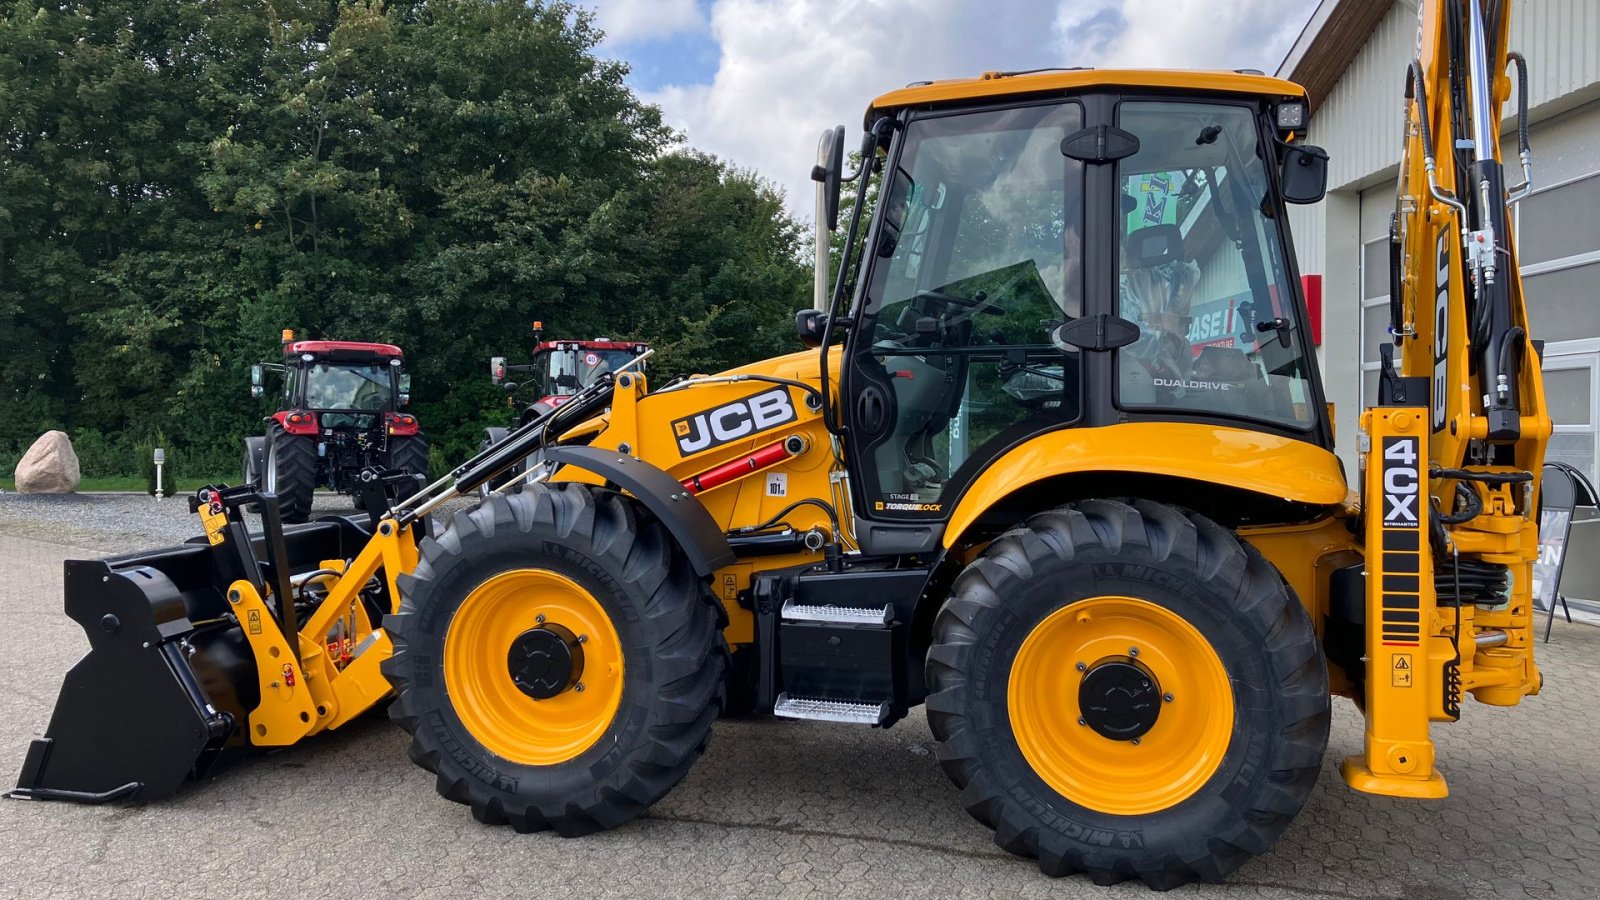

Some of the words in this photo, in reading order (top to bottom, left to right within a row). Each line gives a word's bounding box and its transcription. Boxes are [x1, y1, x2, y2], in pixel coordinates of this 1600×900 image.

[1434, 236, 1448, 428] JCB
[1154, 378, 1229, 390] DUALDRIVE
[679, 389, 793, 453] JCB
[770, 483, 780, 495] 101
[886, 502, 942, 511] TORQUELOCK
[1384, 440, 1418, 520] 4CX
[1009, 786, 1114, 847] MICHELIN
